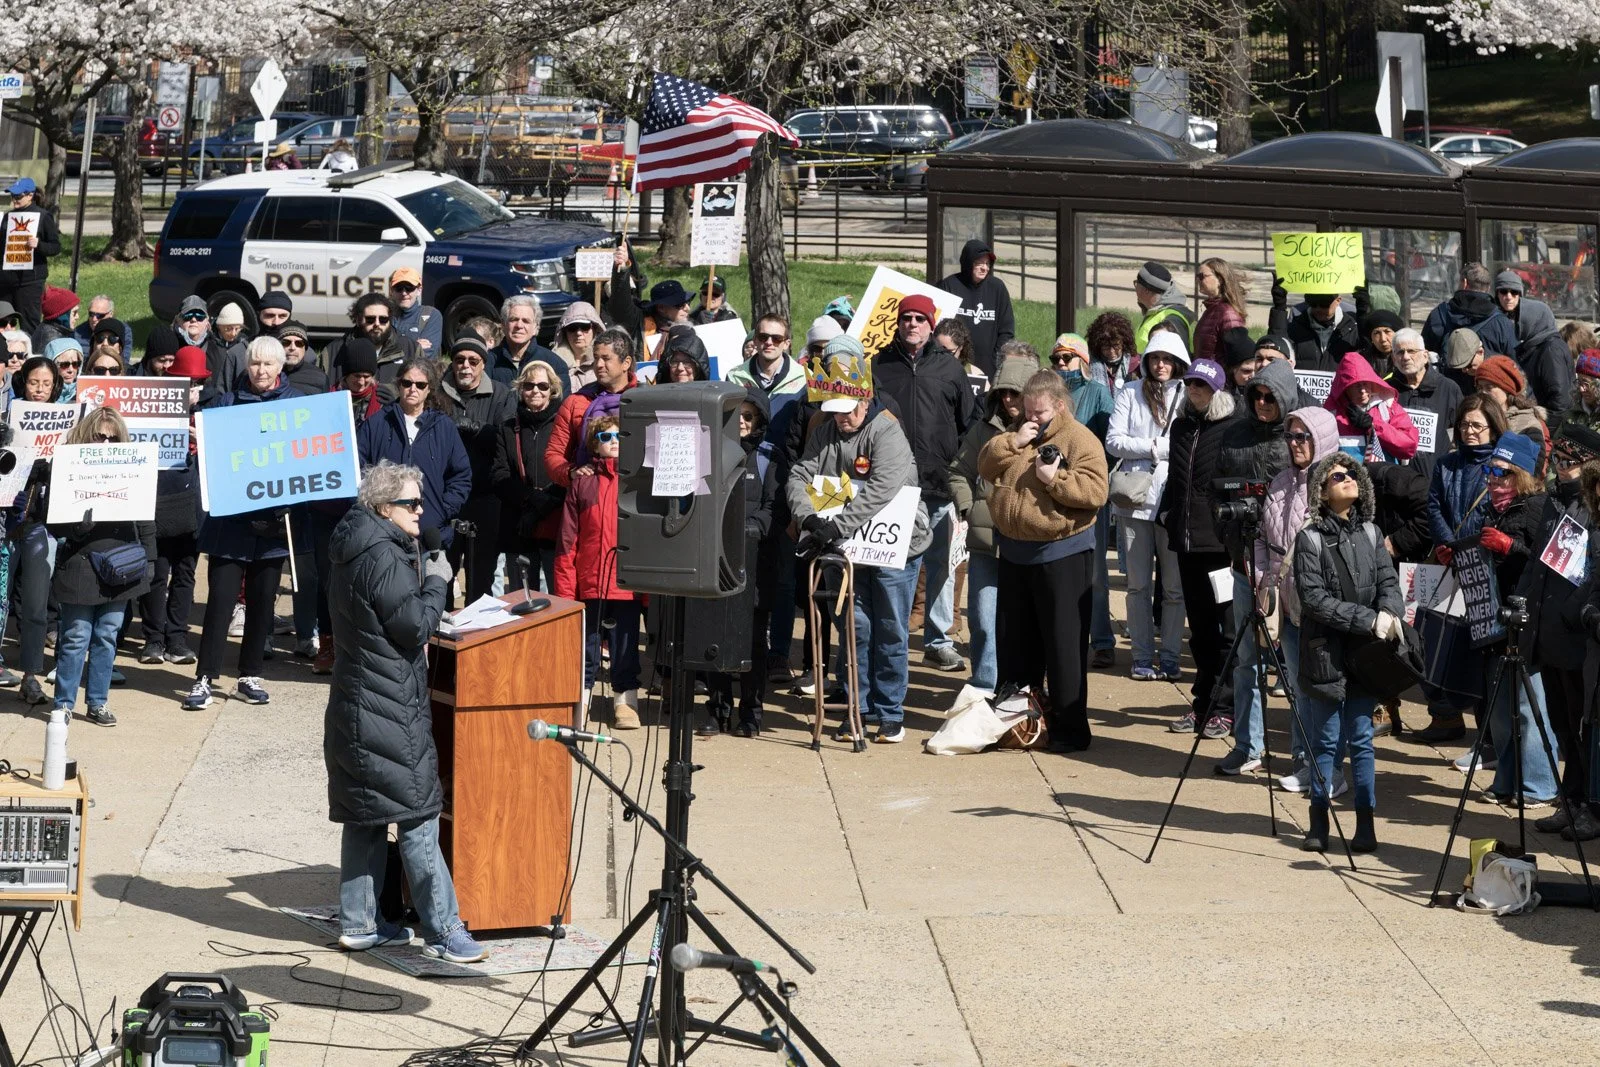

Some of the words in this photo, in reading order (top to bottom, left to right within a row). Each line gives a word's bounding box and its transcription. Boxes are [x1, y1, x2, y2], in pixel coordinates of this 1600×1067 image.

[169, 247, 212, 256] 202-962-2121
[1282, 235, 1361, 259] SCIENCE
[265, 261, 315, 271] MetroTransit
[425, 255, 447, 263] 24637
[1308, 259, 1333, 269] OVER
[1286, 271, 1342, 284] STUPIDITY
[265, 272, 386, 298] POLICE
[109, 386, 131, 399] NO
[132, 387, 185, 401] PUPPET
[814, 380, 829, 391] NO
[832, 382, 871, 398] KINGS!
[119, 401, 187, 414] MASTERS.
[23, 409, 75, 421] SPREAD
[260, 408, 312, 433] RIP
[19, 419, 74, 431] VACCINES
[34, 432, 62, 446] NOT
[79, 447, 103, 458] FREE
[107, 447, 138, 456] SPEECH
[230, 432, 346, 472] FUTURE
[131, 456, 147, 466] Right
[246, 470, 342, 500] CURES
[861, 547, 897, 563] TRUMP
[1544, 551, 1554, 564] NO
[1554, 548, 1569, 572] KINGS
[1459, 564, 1491, 586] NEVER
[1464, 583, 1490, 604] MADE
